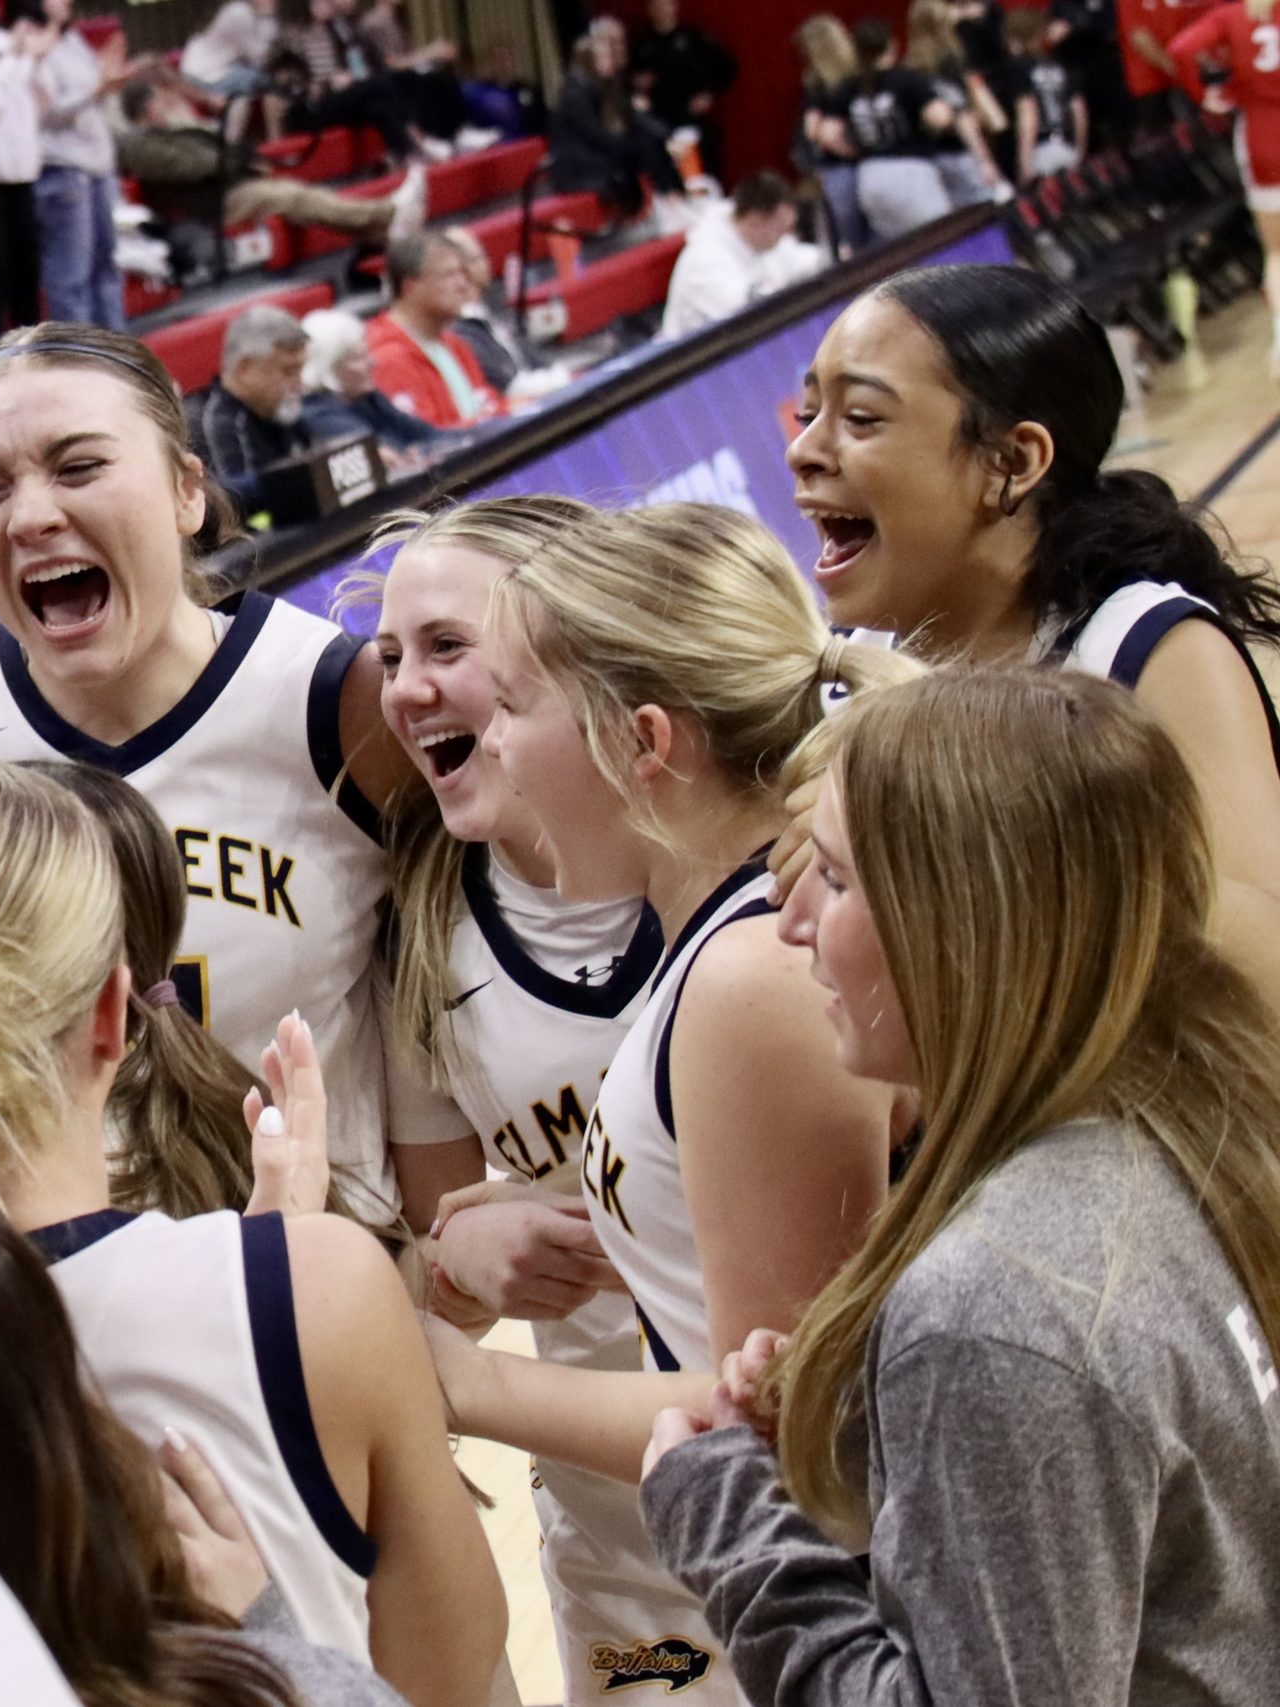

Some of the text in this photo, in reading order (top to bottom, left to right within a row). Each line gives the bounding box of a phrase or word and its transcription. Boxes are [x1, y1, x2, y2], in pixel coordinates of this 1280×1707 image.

[173, 827, 304, 930] EEK
[493, 1083, 589, 1181] ELM
[592, 1644, 691, 1674] Buffaloes
